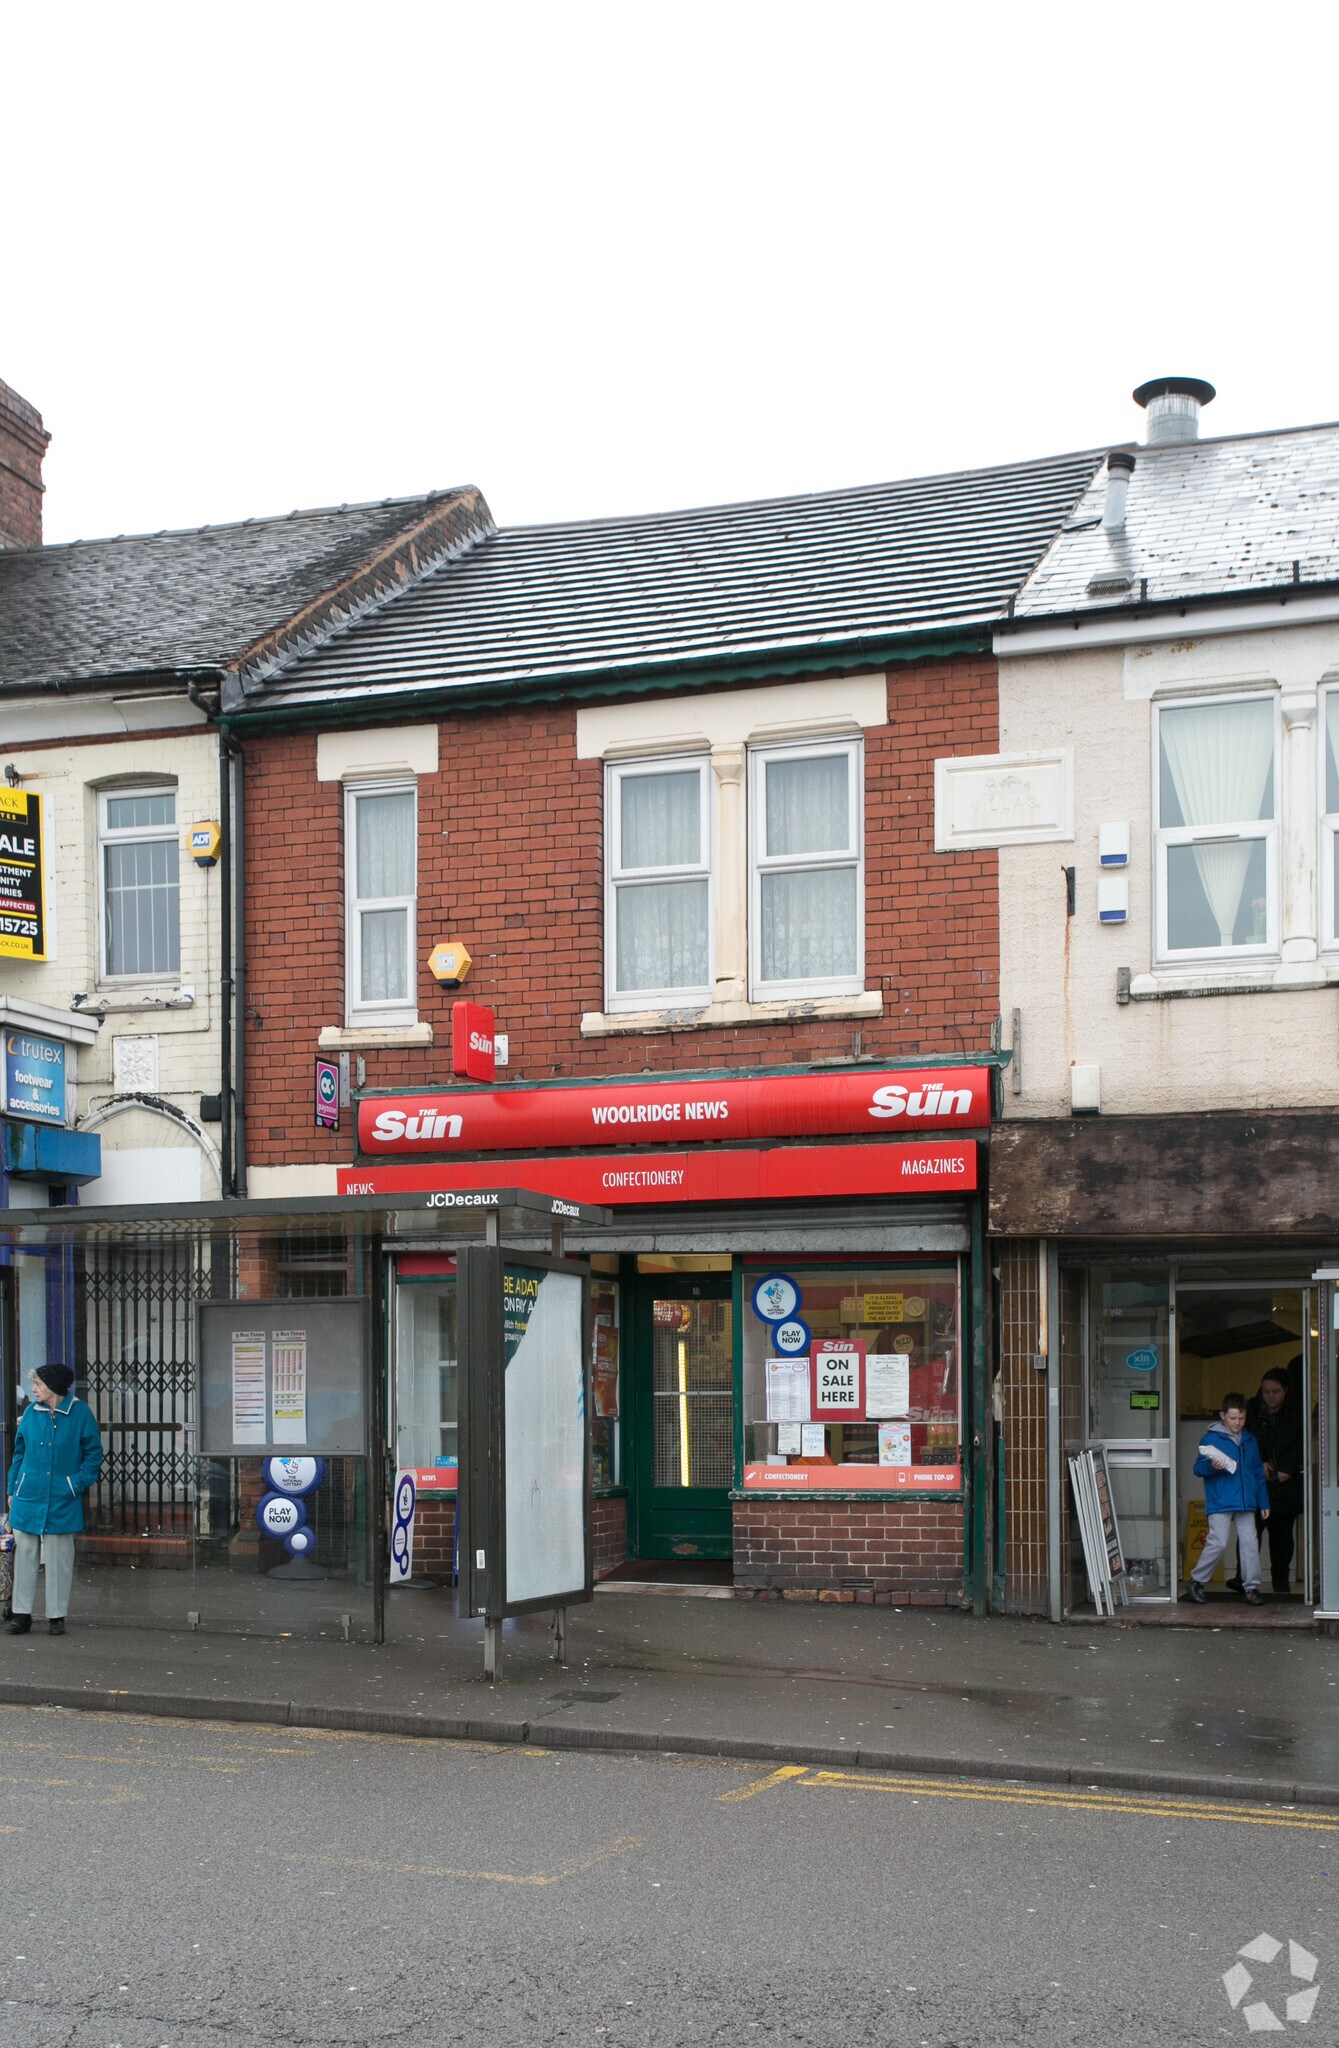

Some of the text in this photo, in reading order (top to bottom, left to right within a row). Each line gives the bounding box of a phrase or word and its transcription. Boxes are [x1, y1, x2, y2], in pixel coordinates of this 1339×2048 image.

[0, 834, 35, 856] ALE
[192, 834, 210, 844] ADT
[0, 917, 38, 936] 15725
[0, 940, 30, 950] CK.CO.UK
[21, 1039, 62, 1064] trutex
[15, 1070, 53, 1089] footwear
[921, 1083, 944, 1091] THE
[32, 1088, 40, 1100] &
[867, 1085, 973, 1118] Sun
[9, 1098, 60, 1116] accessories
[418, 1108, 439, 1116] THE
[592, 1101, 729, 1124] WOOLRIDGE NEWS
[371, 1110, 463, 1141] Sun
[901, 1158, 965, 1175] MAGAZINES
[602, 1170, 684, 1187] CONFECTIONERY
[426, 1193, 499, 1207] JCDecaux
[550, 1200, 580, 1217] JCDecaux
[504, 1275, 514, 1294] BE
[822, 1341, 854, 1352] Sun
[826, 1359, 849, 1370] ON
[822, 1375, 853, 1386] SALE
[822, 1391, 854, 1402] HERE
